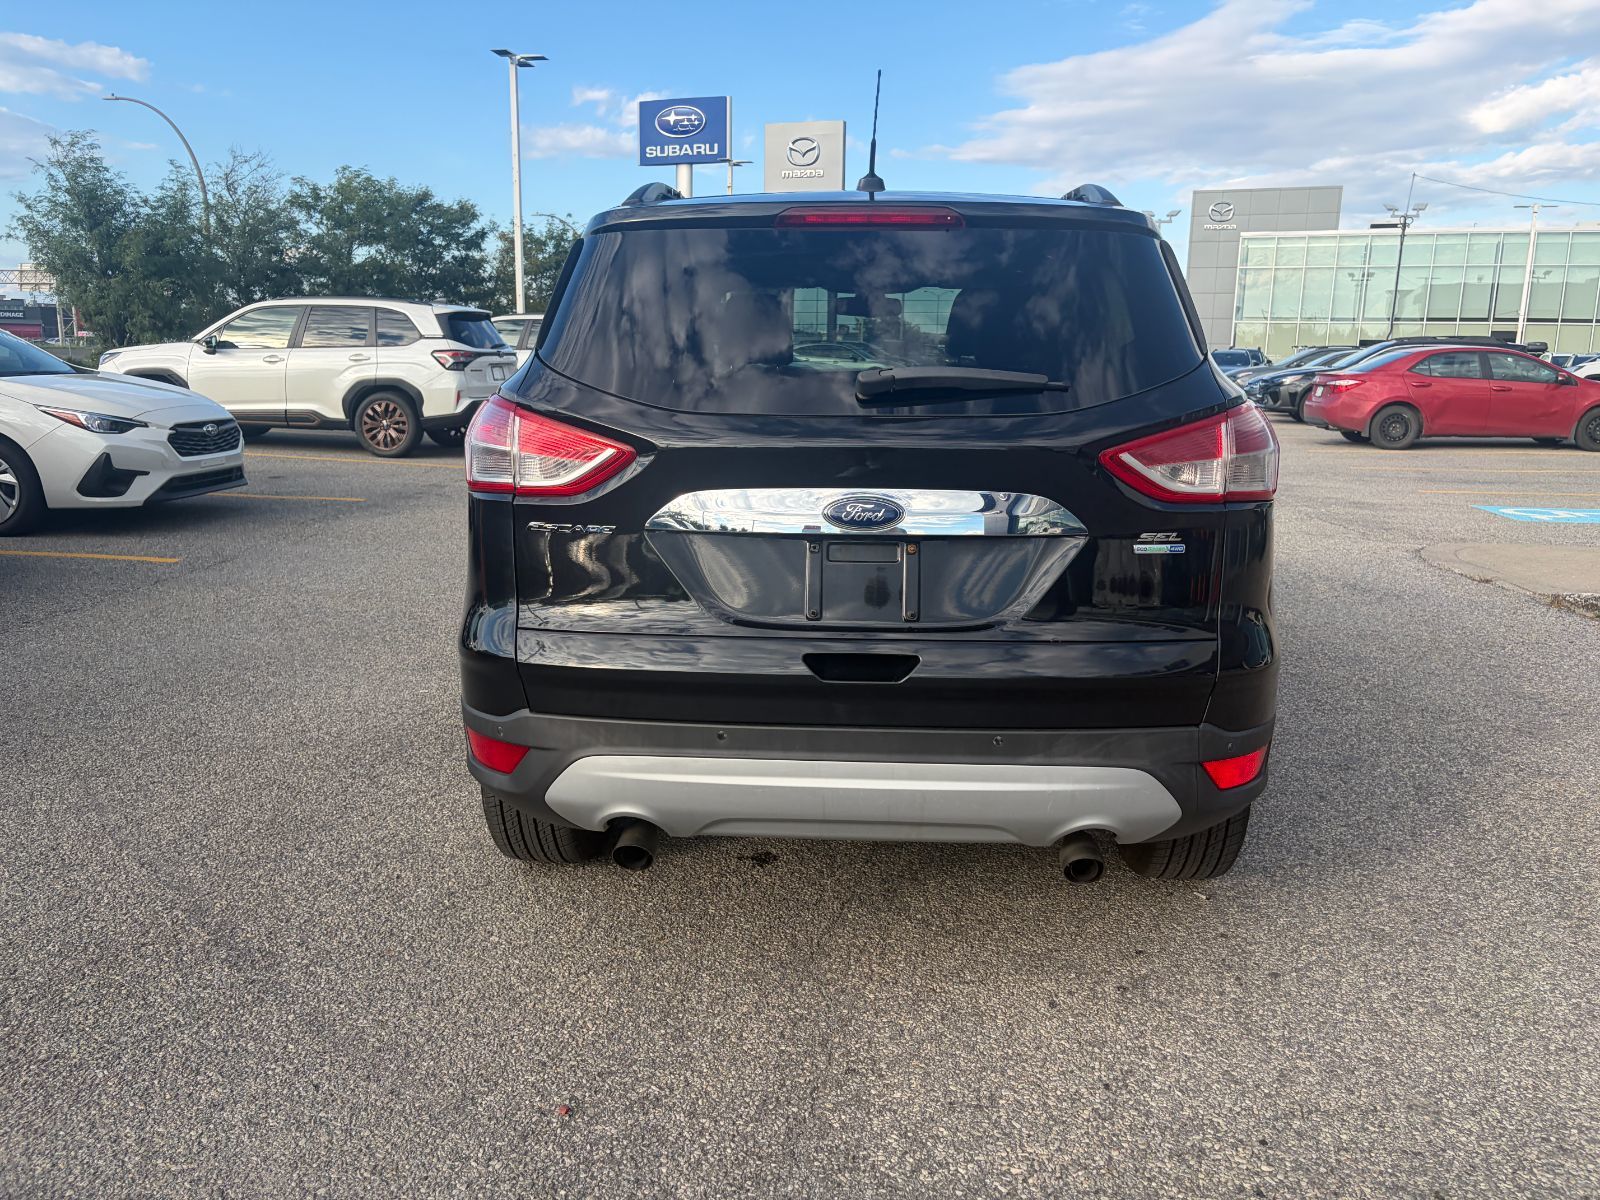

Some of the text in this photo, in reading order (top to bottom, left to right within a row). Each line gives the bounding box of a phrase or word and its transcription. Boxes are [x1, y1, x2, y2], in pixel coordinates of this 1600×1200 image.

[646, 143, 718, 158] SUBARU
[781, 169, 824, 179] mazda
[841, 503, 886, 522] Ford
[527, 521, 616, 534] ESCAPE
[1137, 532, 1182, 541] SEL
